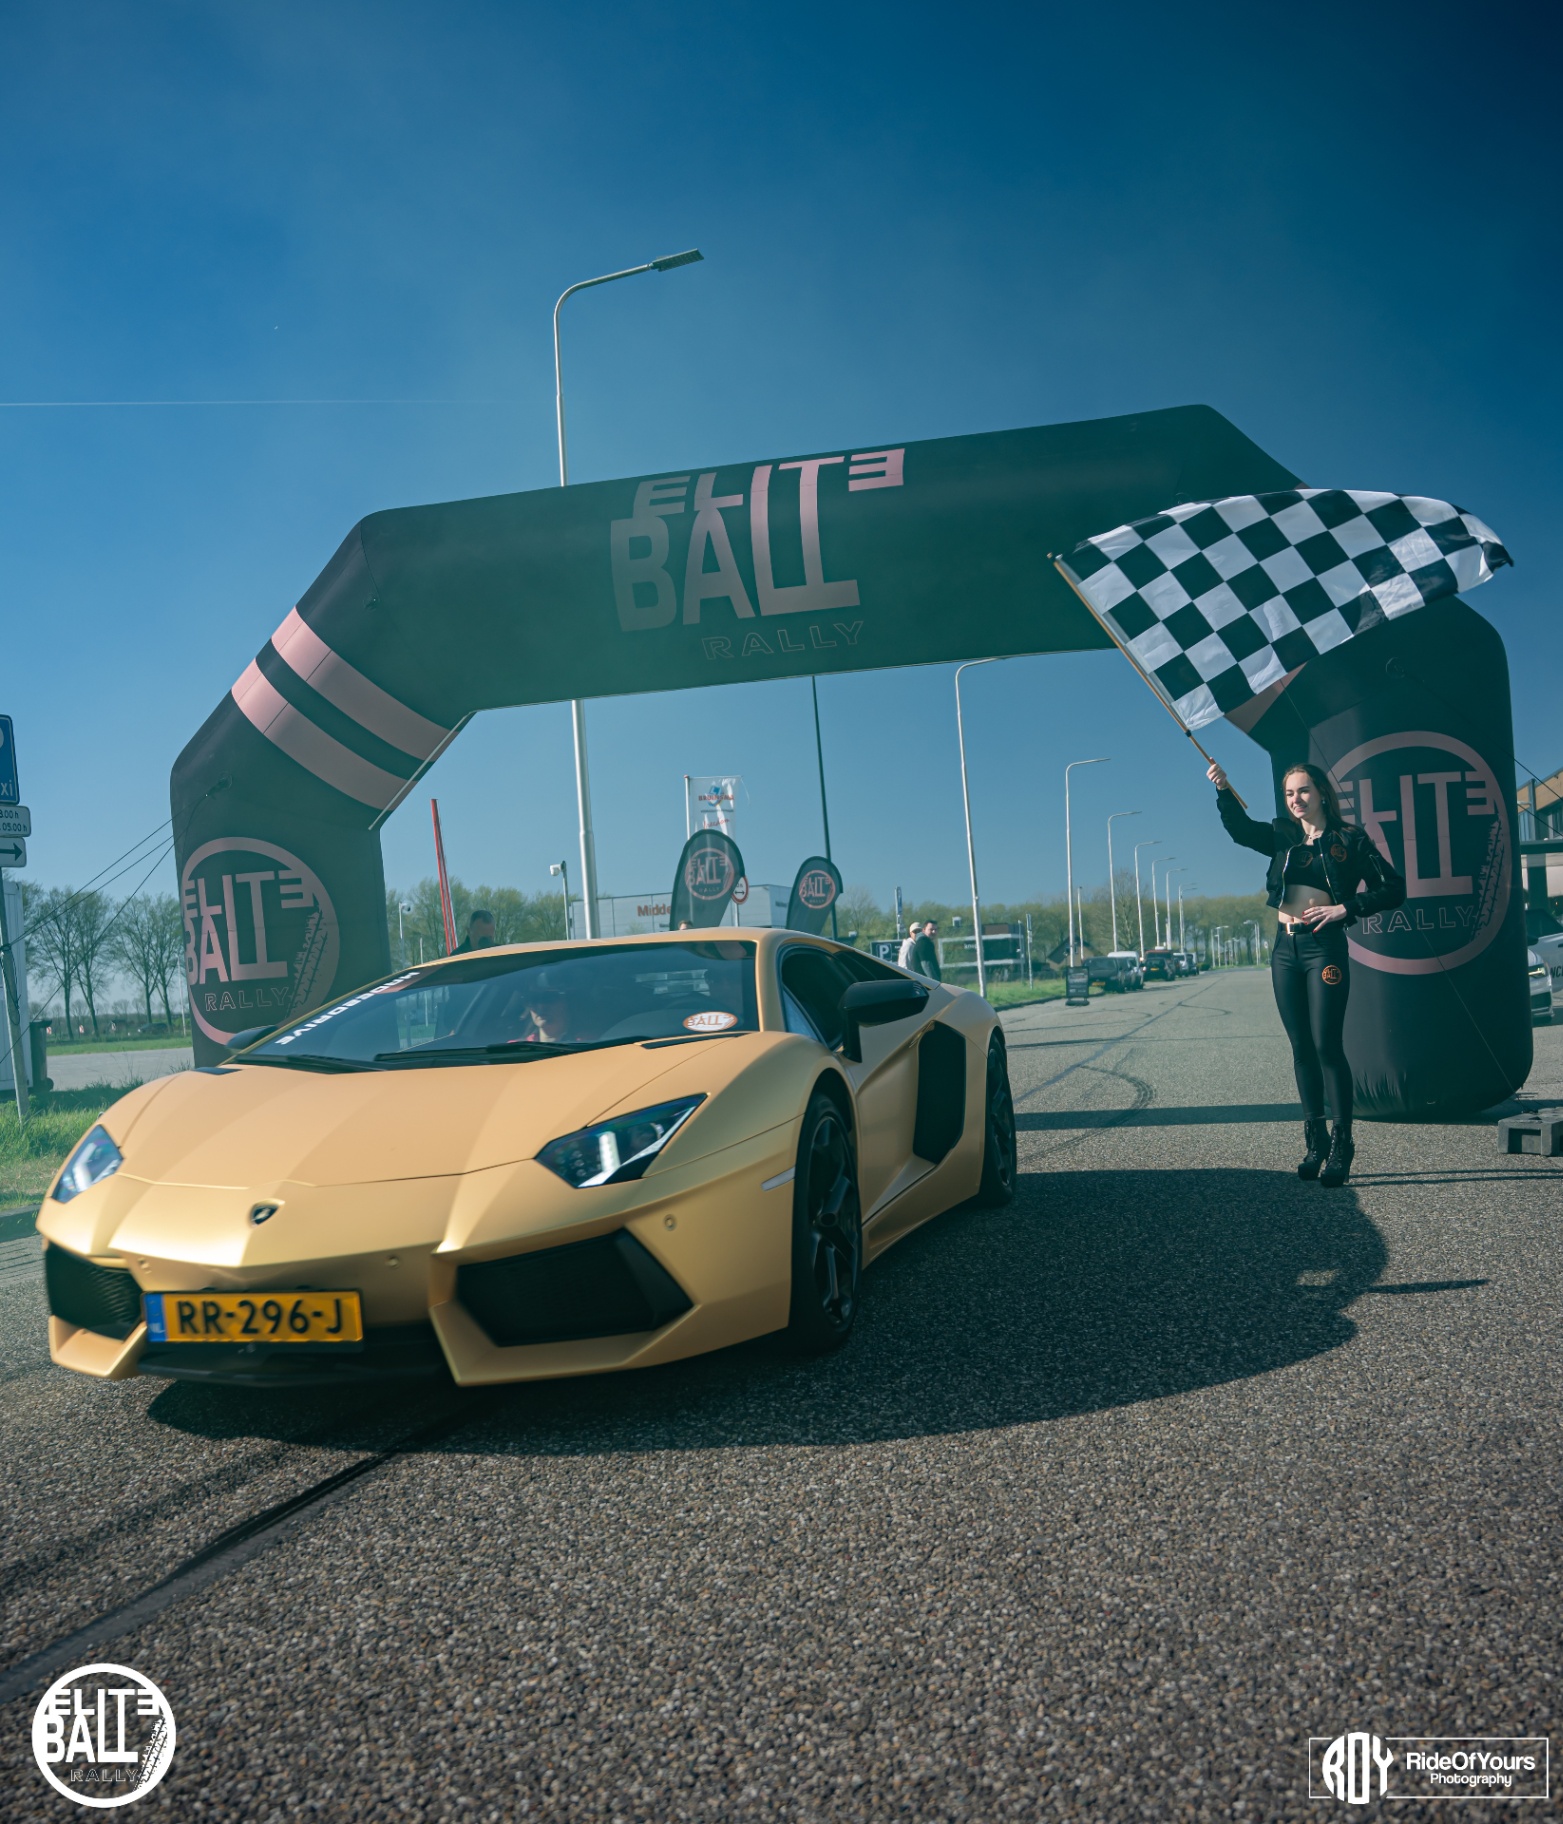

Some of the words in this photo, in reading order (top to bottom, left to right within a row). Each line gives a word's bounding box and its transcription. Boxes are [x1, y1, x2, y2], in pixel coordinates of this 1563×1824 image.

[701, 620, 864, 661] RALLY
[1363, 905, 1476, 935] RALLY
[205, 985, 290, 1012] RALLY
[178, 1298, 343, 1335] RR-296-J
